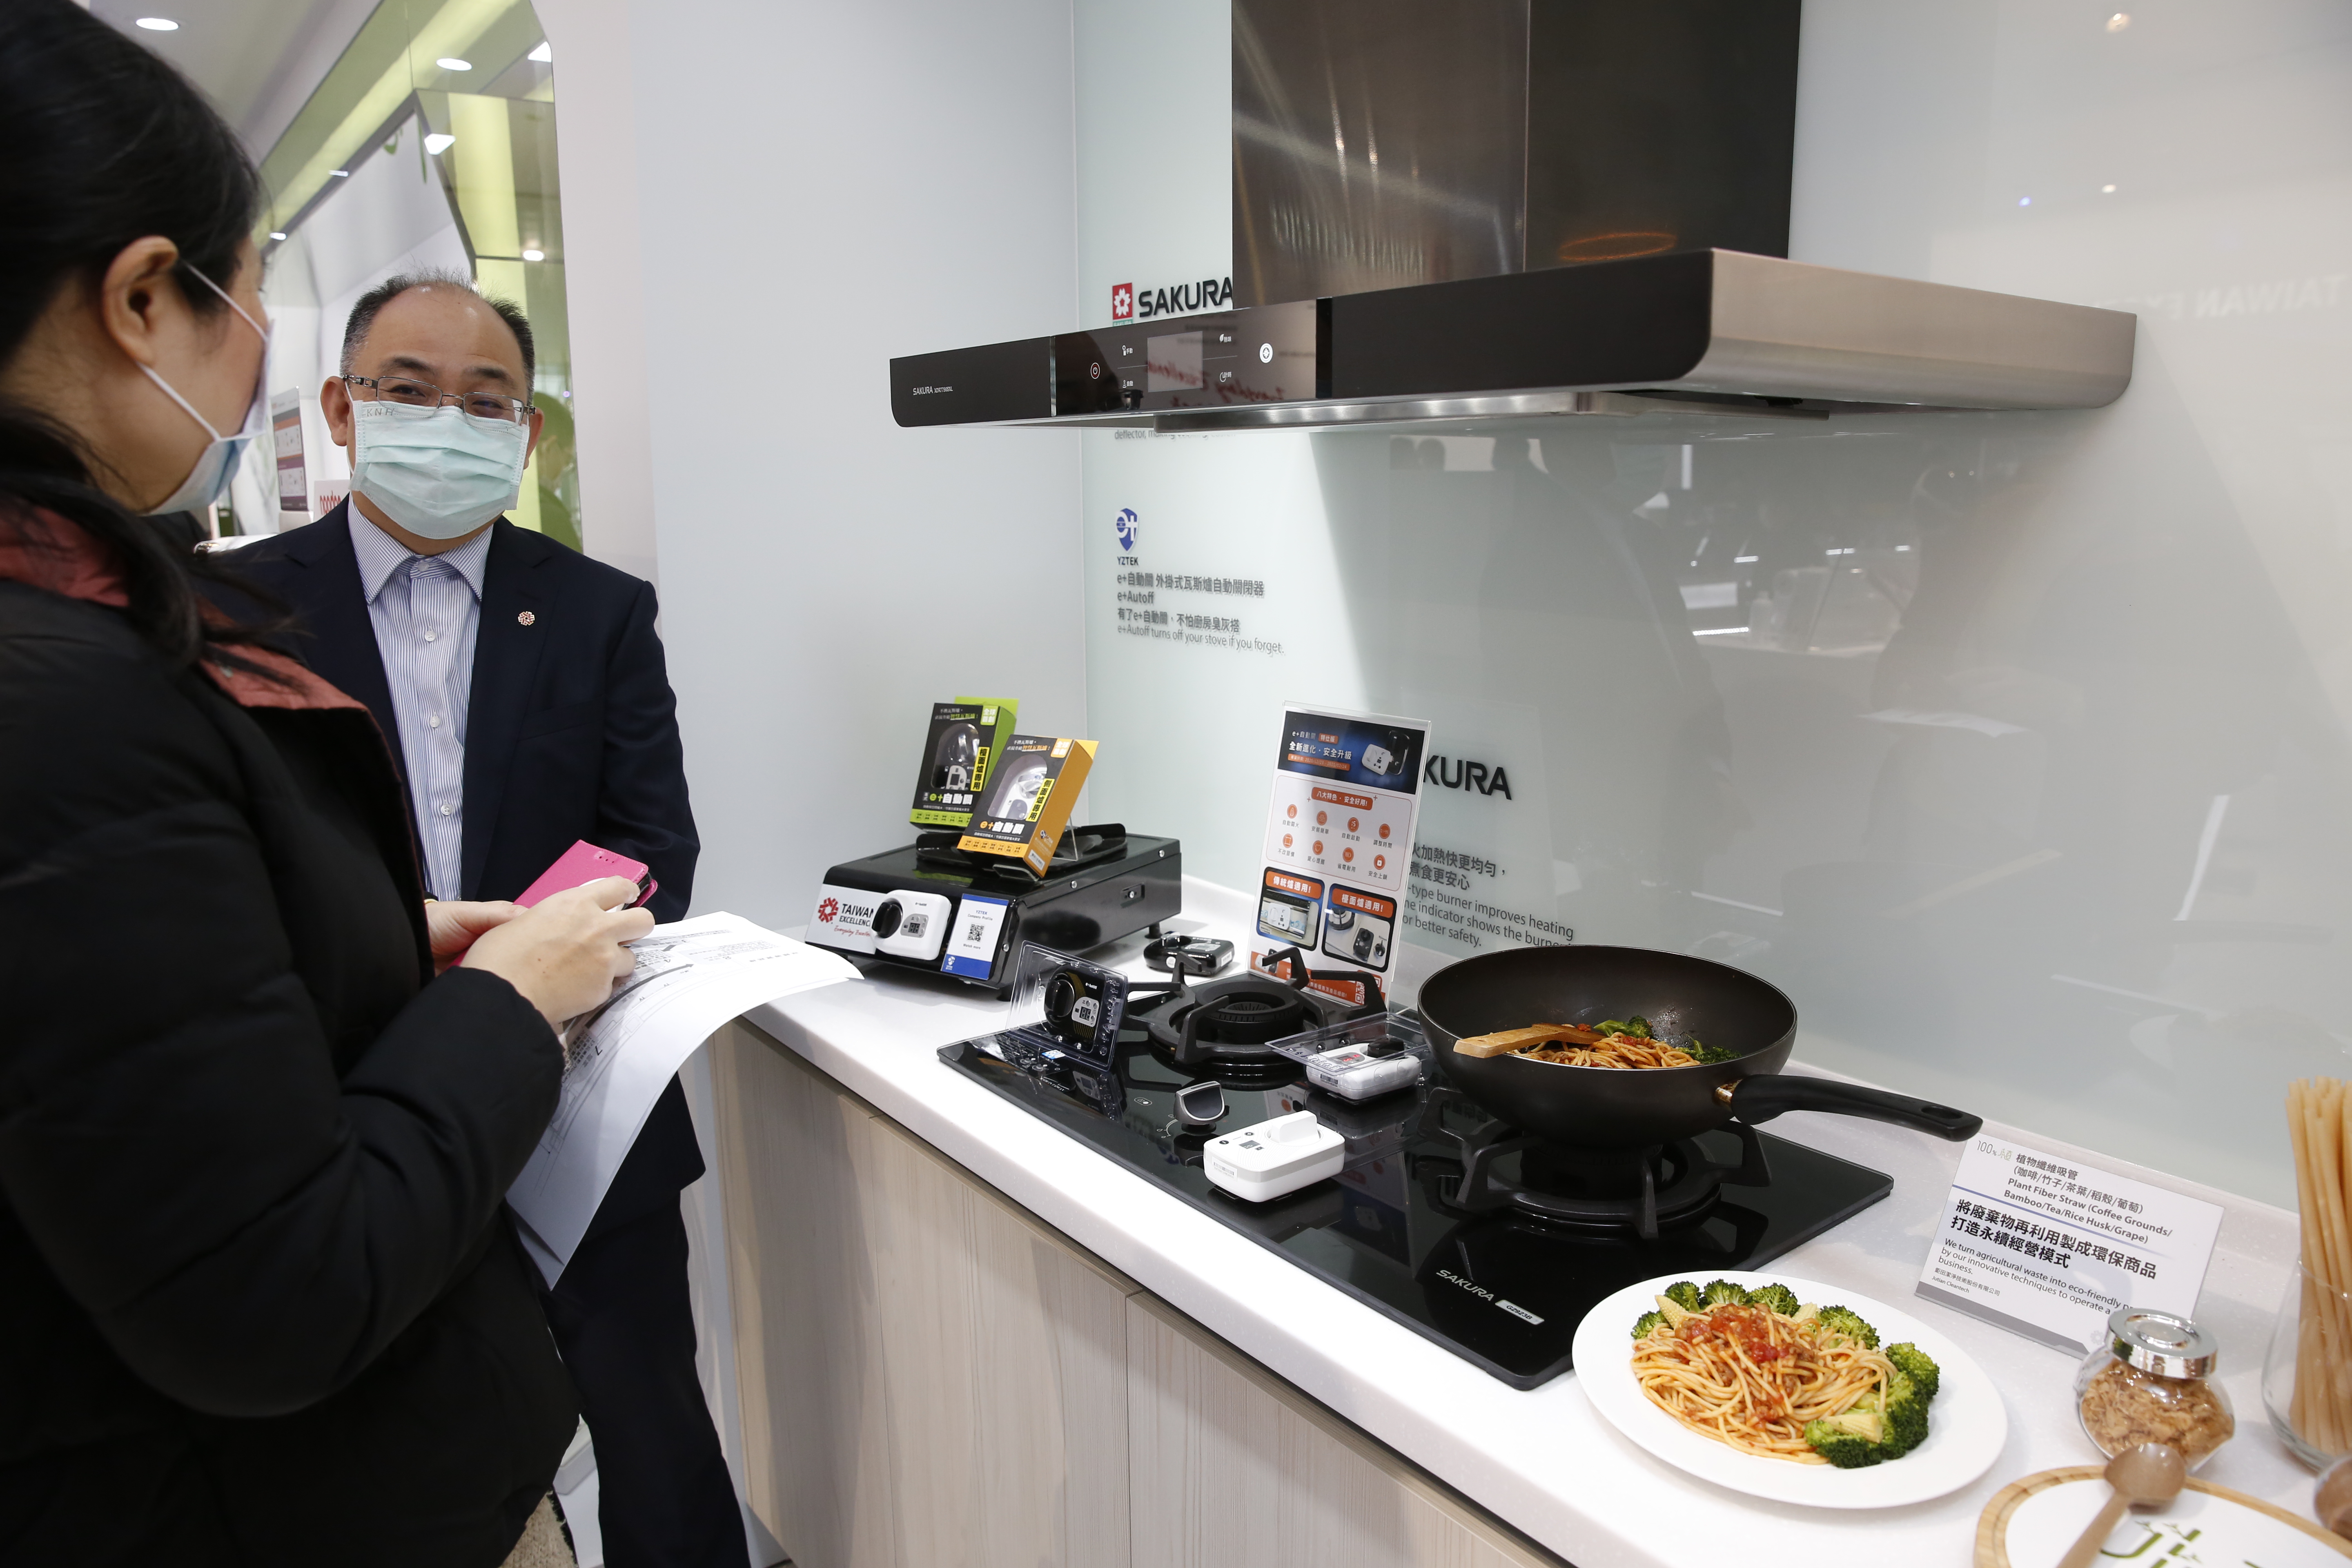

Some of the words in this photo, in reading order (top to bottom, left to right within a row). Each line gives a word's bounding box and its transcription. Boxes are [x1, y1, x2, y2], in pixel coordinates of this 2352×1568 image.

[1138, 276, 1232, 318] SAKURA
[913, 386, 933, 395] SAKURA
[1117, 556, 1139, 566] YZTEK
[1117, 590, 1155, 604] e+Autoff
[1118, 624, 1149, 636] e+Autoff
[1151, 627, 1170, 639] turns
[1172, 630, 1183, 640] off
[1184, 633, 1203, 644] your
[1205, 634, 1226, 646] stove
[1229, 635, 1236, 646] if
[1236, 639, 1252, 650] you
[1254, 637, 1285, 655] forget.
[1415, 915, 1446, 935] better
[1448, 928, 1482, 948] safety.
[1419, 900, 1464, 924] indicator
[1467, 915, 1501, 935] shows
[1503, 925, 1522, 941] the
[1525, 930, 1562, 947] burn
[1437, 889, 1472, 910] burner
[1474, 900, 1526, 925] improves
[1529, 914, 1574, 941] heating
[2016, 1153, 2079, 1180] 植物纖維吸管
[2004, 1189, 2085, 1222] Bamboo/Tea/Rice
[2086, 1215, 2149, 1244] Husk/Grape)
[2008, 1178, 2031, 1192] Plant
[2033, 1186, 2058, 1200] Fiber
[2058, 1194, 2087, 1209] Straw
[2087, 1203, 2123, 1221] (Coffee
[2124, 1216, 2173, 1237] Grounds/
[1951, 1215, 2071, 1268] 打造永續經營模式
[1956, 1199, 2158, 1279] 將廢棄物再利用製成環保商品
[1931, 1275, 1946, 1285] Jutian
[1946, 1281, 1970, 1294] Cleantech
[1934, 1267, 2000, 1296] 鉅田潔淨技術股份有限公司
[1938, 1256, 1973, 1275] business.
[1941, 1246, 1951, 1257] by
[1952, 1252, 1967, 1262] our
[1967, 1256, 2010, 1278] innovative
[2010, 1272, 2057, 1295] techniques
[2058, 1290, 2068, 1299] to
[2069, 1295, 2103, 1313] operate
[1945, 1238, 1957, 1249] We
[1958, 1243, 1975, 1255] turn
[1976, 1250, 2023, 1272] agricultural
[2024, 1268, 2049, 1281] waste
[2049, 1276, 2067, 1288] into
[2068, 1284, 2121, 1309] eco-friendly
[1436, 1269, 1494, 1301] SAKURA
[1506, 1304, 1533, 1320] G2923B
